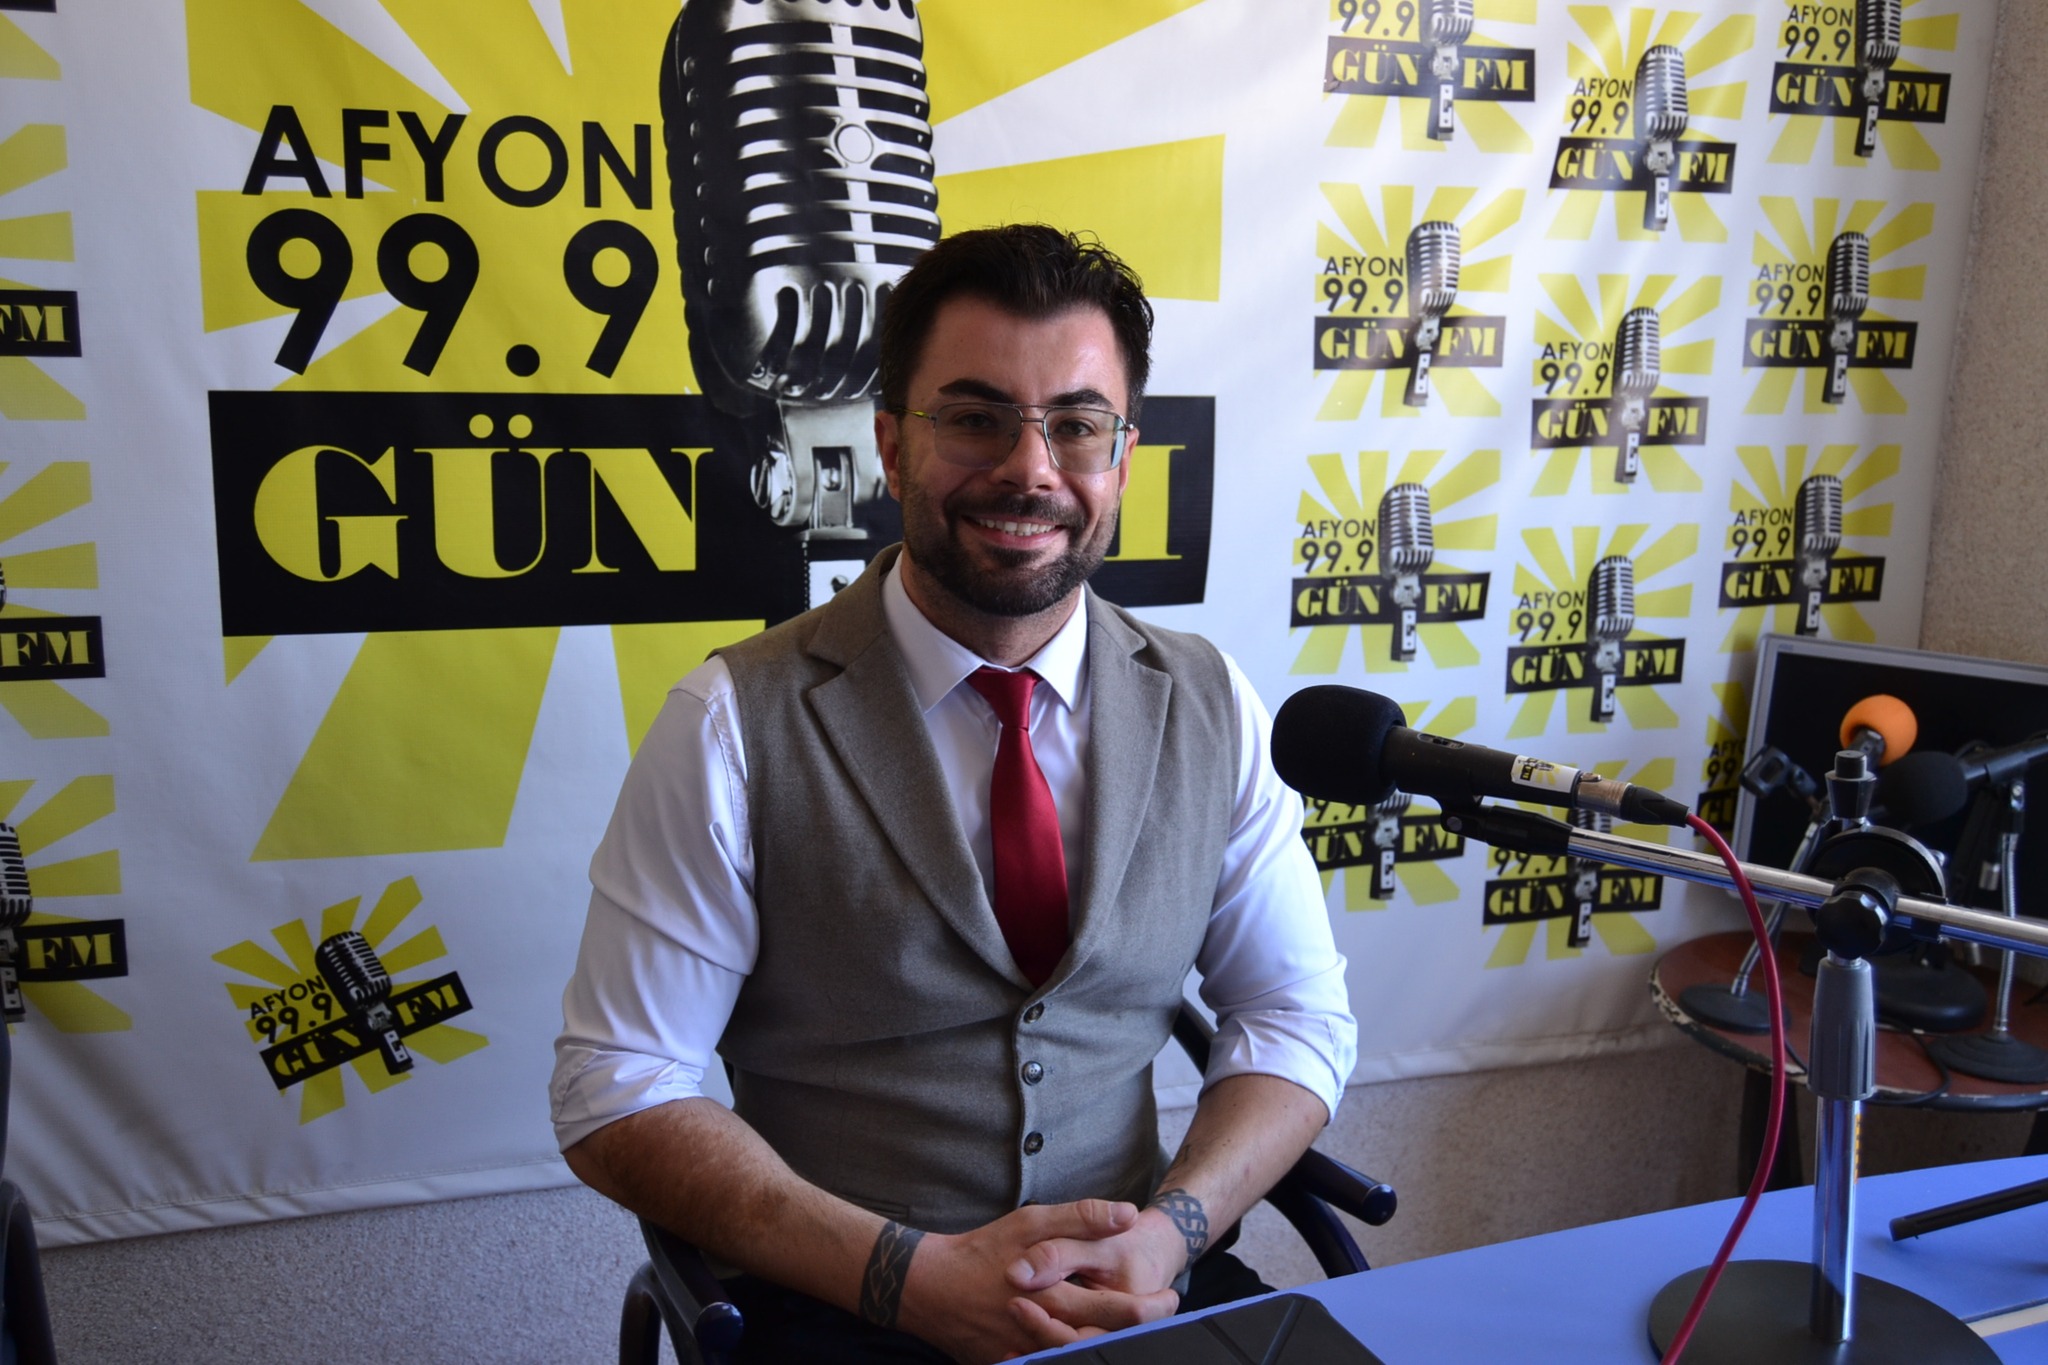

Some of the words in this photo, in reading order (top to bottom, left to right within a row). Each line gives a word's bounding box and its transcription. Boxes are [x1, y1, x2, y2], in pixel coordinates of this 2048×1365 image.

[1338, 0, 1415, 37] 99.9
[1787, 4, 1853, 27] AFYON
[1784, 25, 1851, 62] 99.9
[1332, 44, 1421, 86] GÜN
[1461, 56, 1528, 91] FM
[1573, 77, 1633, 99] AFYON
[1775, 68, 1856, 107] GÜN
[1885, 80, 1943, 113] FM
[1570, 99, 1630, 135] 99.9
[242, 105, 653, 210] AFYON
[1556, 142, 1635, 181] GÜN
[1678, 152, 1730, 183] FM
[1323, 257, 1404, 277] AFYON
[1757, 264, 1824, 282] AFYON
[246, 208, 659, 379] 99.9
[1323, 278, 1403, 314] 99.9
[1756, 283, 1822, 316] 99.9
[1320, 320, 1410, 360] GÜN
[1438, 326, 1498, 357] FM
[1541, 342, 1614, 361] AFYON
[1750, 323, 1824, 359] GÜN
[1855, 330, 1910, 359] FM
[1541, 363, 1609, 395] 99.9
[1537, 402, 1611, 440] GÜN
[1647, 407, 1700, 437] FM
[254, 414, 714, 582] GÜN
[1302, 519, 1376, 539] AFYON
[1734, 508, 1794, 527] AFYON
[1301, 539, 1374, 574] 99.9
[1732, 527, 1791, 558] 99.9
[1296, 579, 1382, 618] GÜN
[1424, 582, 1484, 614] FM
[1725, 564, 1794, 600] GÜN
[1828, 566, 1876, 595] FM
[1518, 591, 1586, 610] AFYON
[1516, 609, 1582, 642] 99.9
[0, 630, 94, 667] FM
[1511, 647, 1586, 685] GÜN
[1623, 648, 1679, 678] FM
[1710, 741, 1746, 758] AFY
[1707, 757, 1737, 788] 99
[1306, 827, 1366, 863] ÜN
[1402, 822, 1459, 854] FM
[1488, 880, 1567, 917] GÜN
[1599, 876, 1657, 904] FM
[25, 933, 116, 970] FM
[251, 974, 325, 1019] AFYON
[255, 993, 332, 1044] 99.9
[274, 1022, 362, 1077] GÜN
[395, 983, 461, 1028] FM
